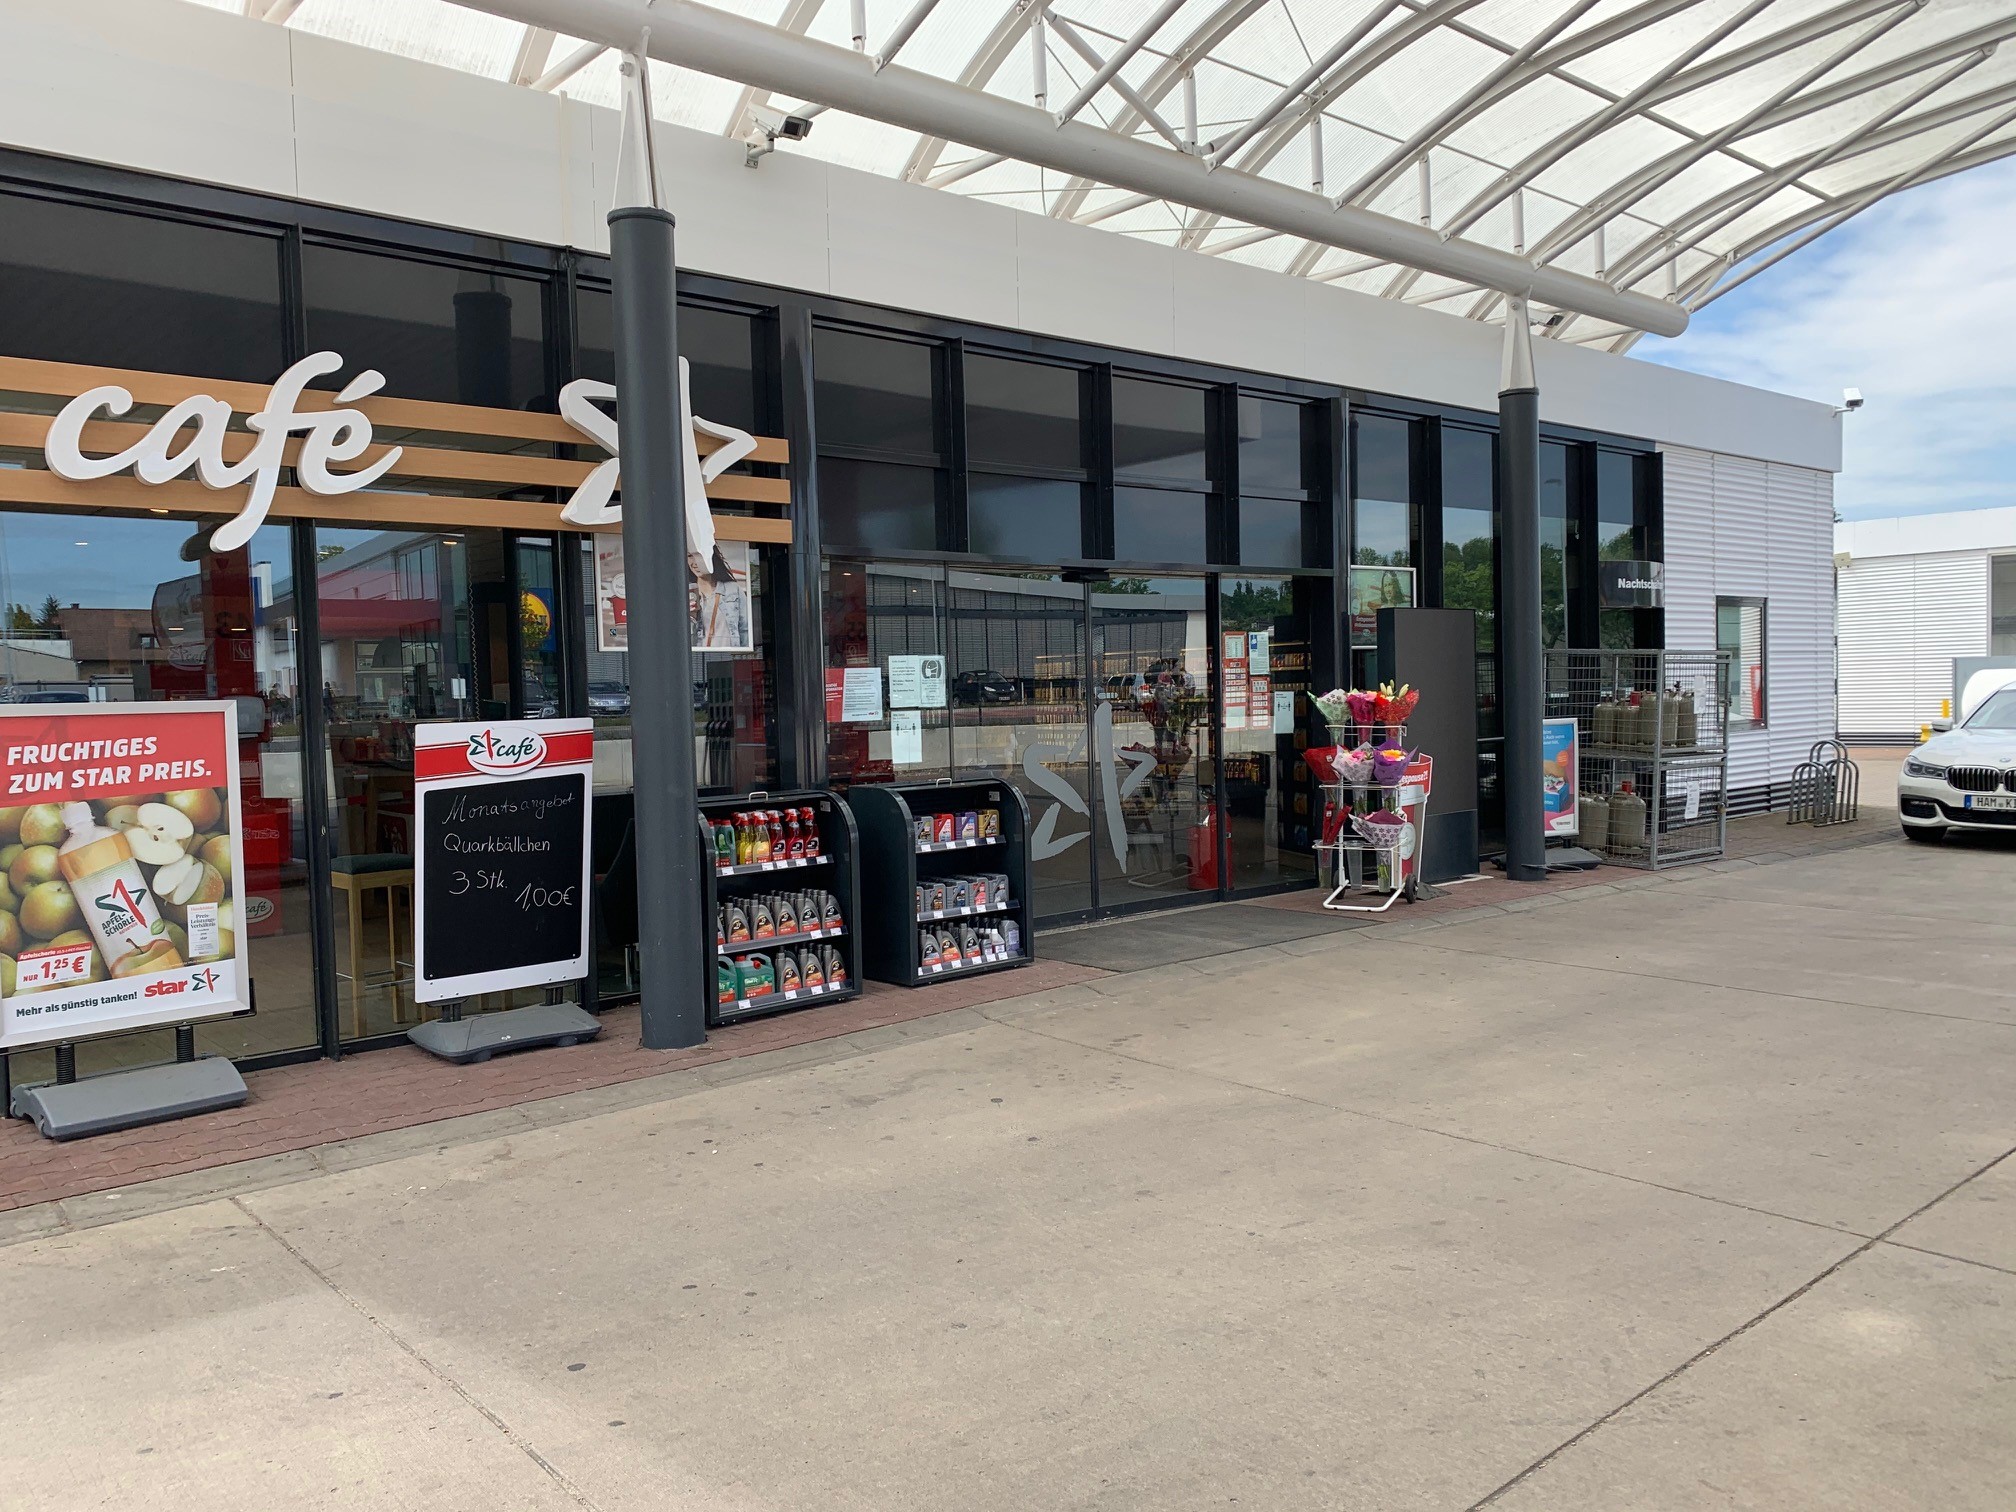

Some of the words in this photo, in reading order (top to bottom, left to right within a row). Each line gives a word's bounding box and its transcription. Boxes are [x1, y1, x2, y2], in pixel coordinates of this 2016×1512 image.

[45, 351, 403, 552] café
[7, 736, 157, 766] FRUCHTIGES
[496, 737, 536, 763] café
[8, 771, 64, 794] ZUM
[71, 765, 131, 788] STAR
[138, 759, 212, 782] PREIS.
[1977, 797, 1997, 807] HAM
[2006, 798, 2016, 809] K
[444, 832, 551, 854] Quarkbällchen
[449, 871, 470, 895] 3
[476, 869, 508, 890] Stk.
[515, 882, 575, 912] 1,00€
[101, 912, 126, 931] APFEL-
[105, 915, 136, 937] SCHORLE
[23, 974, 38, 982] NUR
[144, 978, 188, 997] star
[16, 1006, 43, 1018] Mehr
[45, 1003, 60, 1013] als
[61, 997, 98, 1012] günstig
[101, 991, 138, 1005] tanken!
